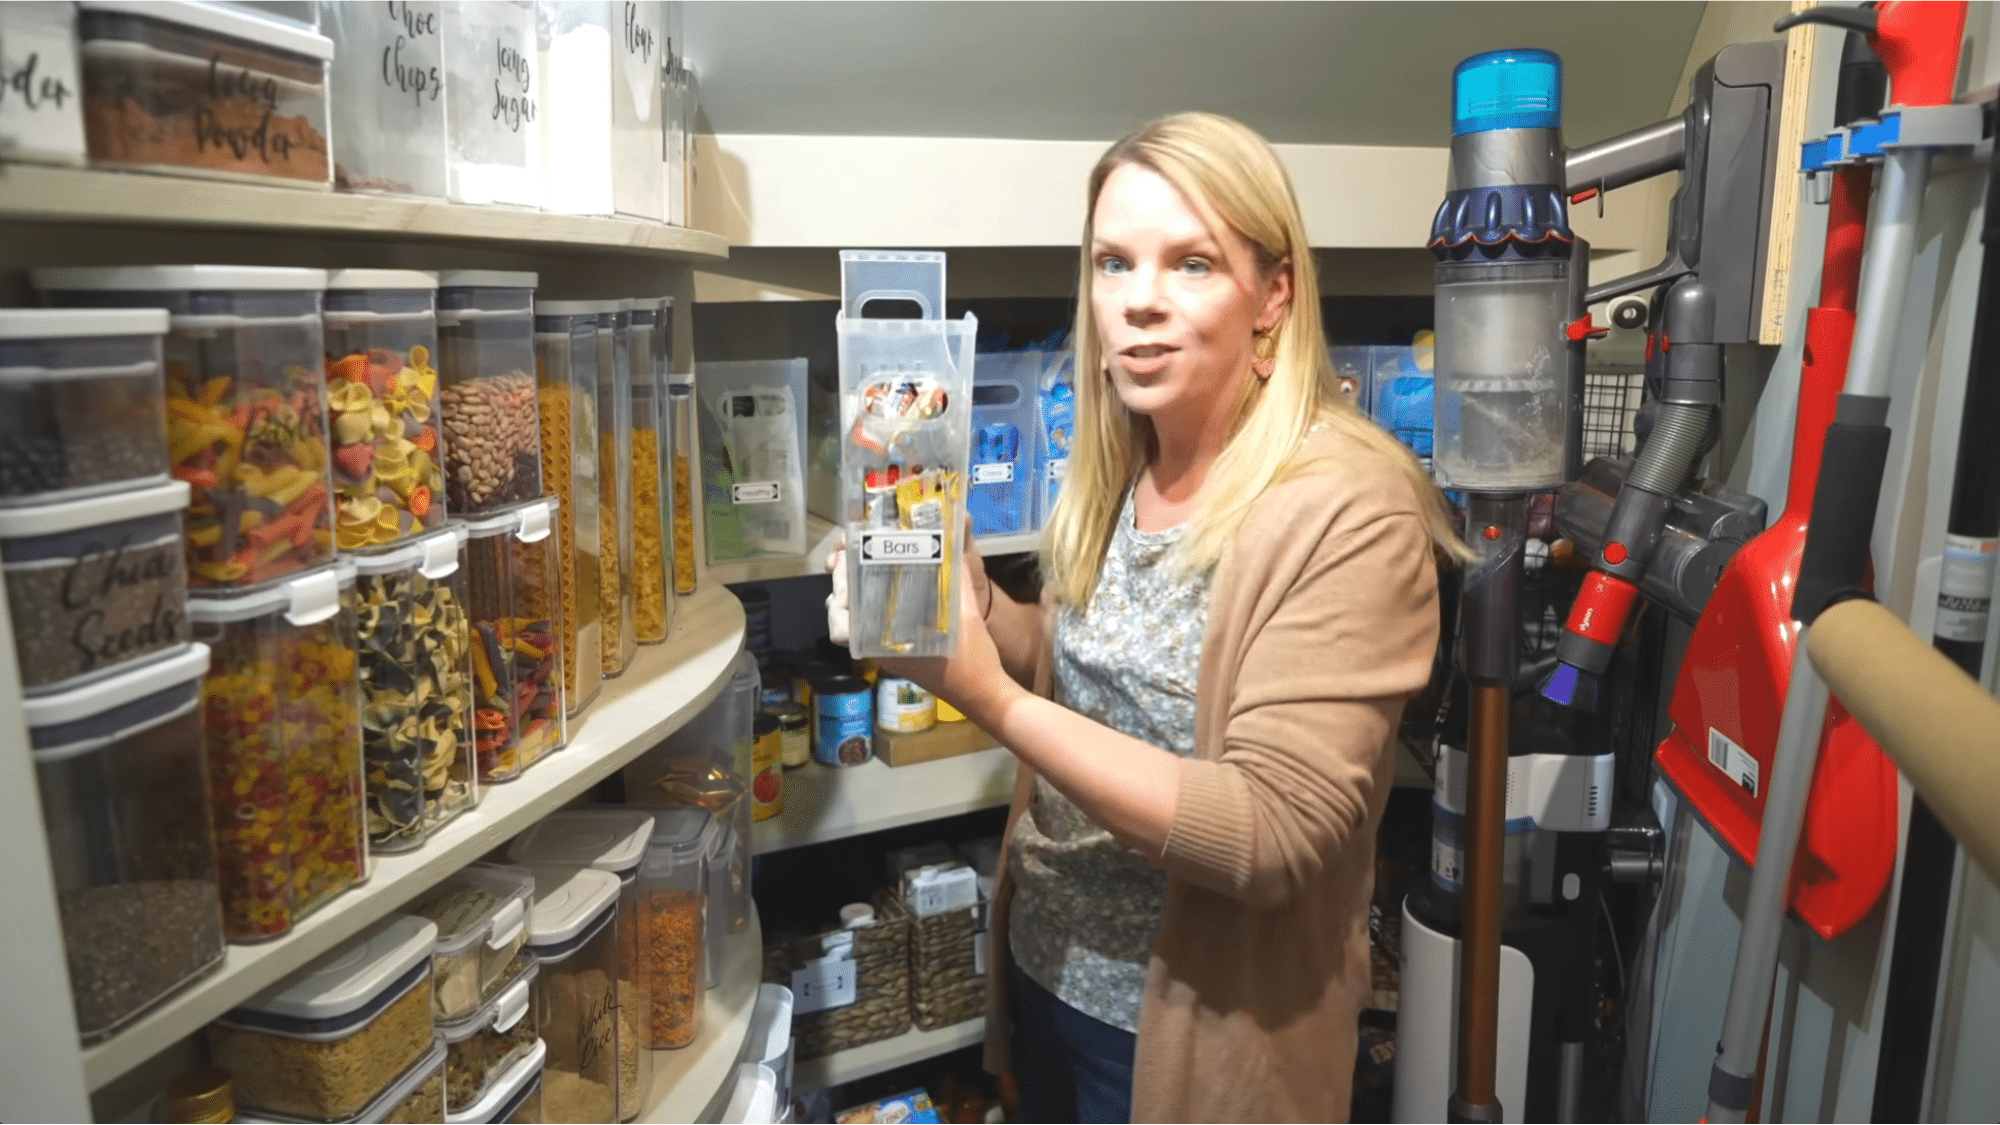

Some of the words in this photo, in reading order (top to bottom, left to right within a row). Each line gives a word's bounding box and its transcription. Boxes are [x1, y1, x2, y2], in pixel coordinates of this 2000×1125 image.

[0, 52, 72, 111] der
[383, 35, 442, 108] Chips
[193, 103, 297, 164] Powder
[492, 78, 537, 133] Sugar
[62, 533, 174, 611] Chia
[883, 540, 920, 554] Bars
[72, 593, 184, 672] Seeds
